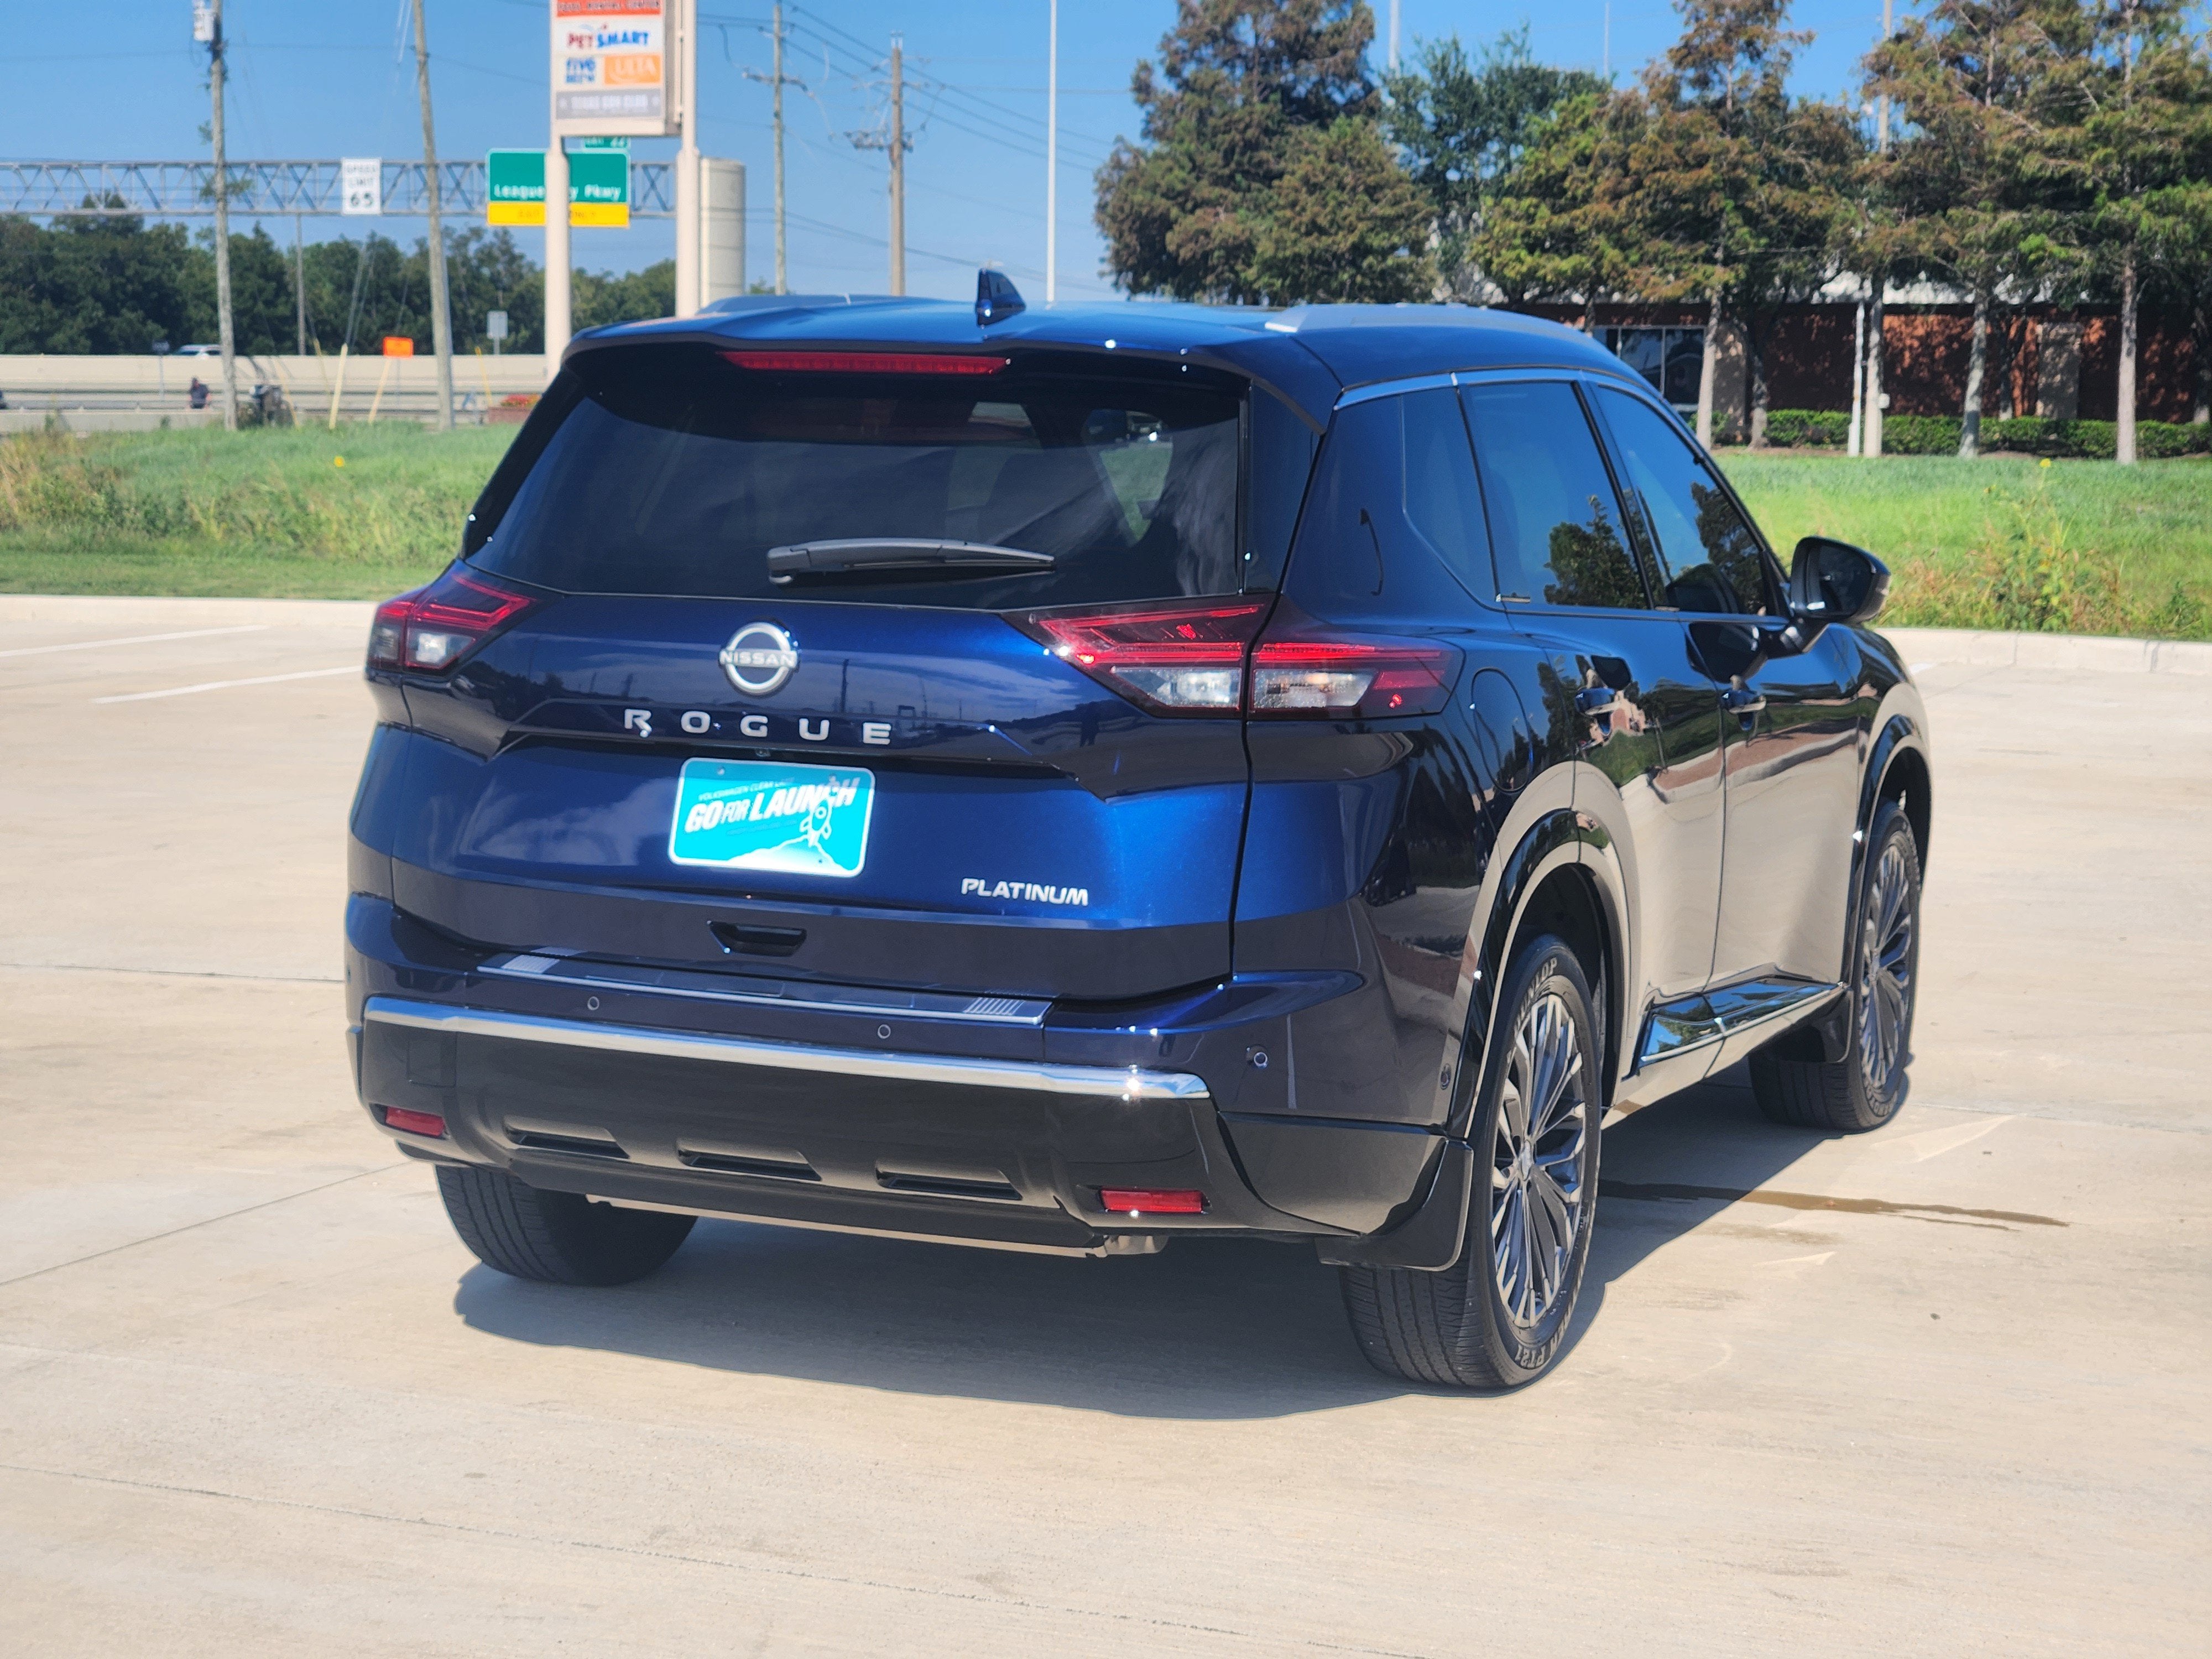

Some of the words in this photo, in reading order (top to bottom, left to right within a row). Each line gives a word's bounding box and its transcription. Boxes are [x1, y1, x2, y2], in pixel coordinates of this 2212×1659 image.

[350, 192, 373, 207] 65
[719, 650, 797, 668] NISSAN
[624, 708, 891, 745] ROGUE
[685, 800, 724, 833] GO
[720, 799, 750, 824] FOR
[748, 776, 860, 822] LAUNCH
[961, 878, 1088, 906] PLATINUM
